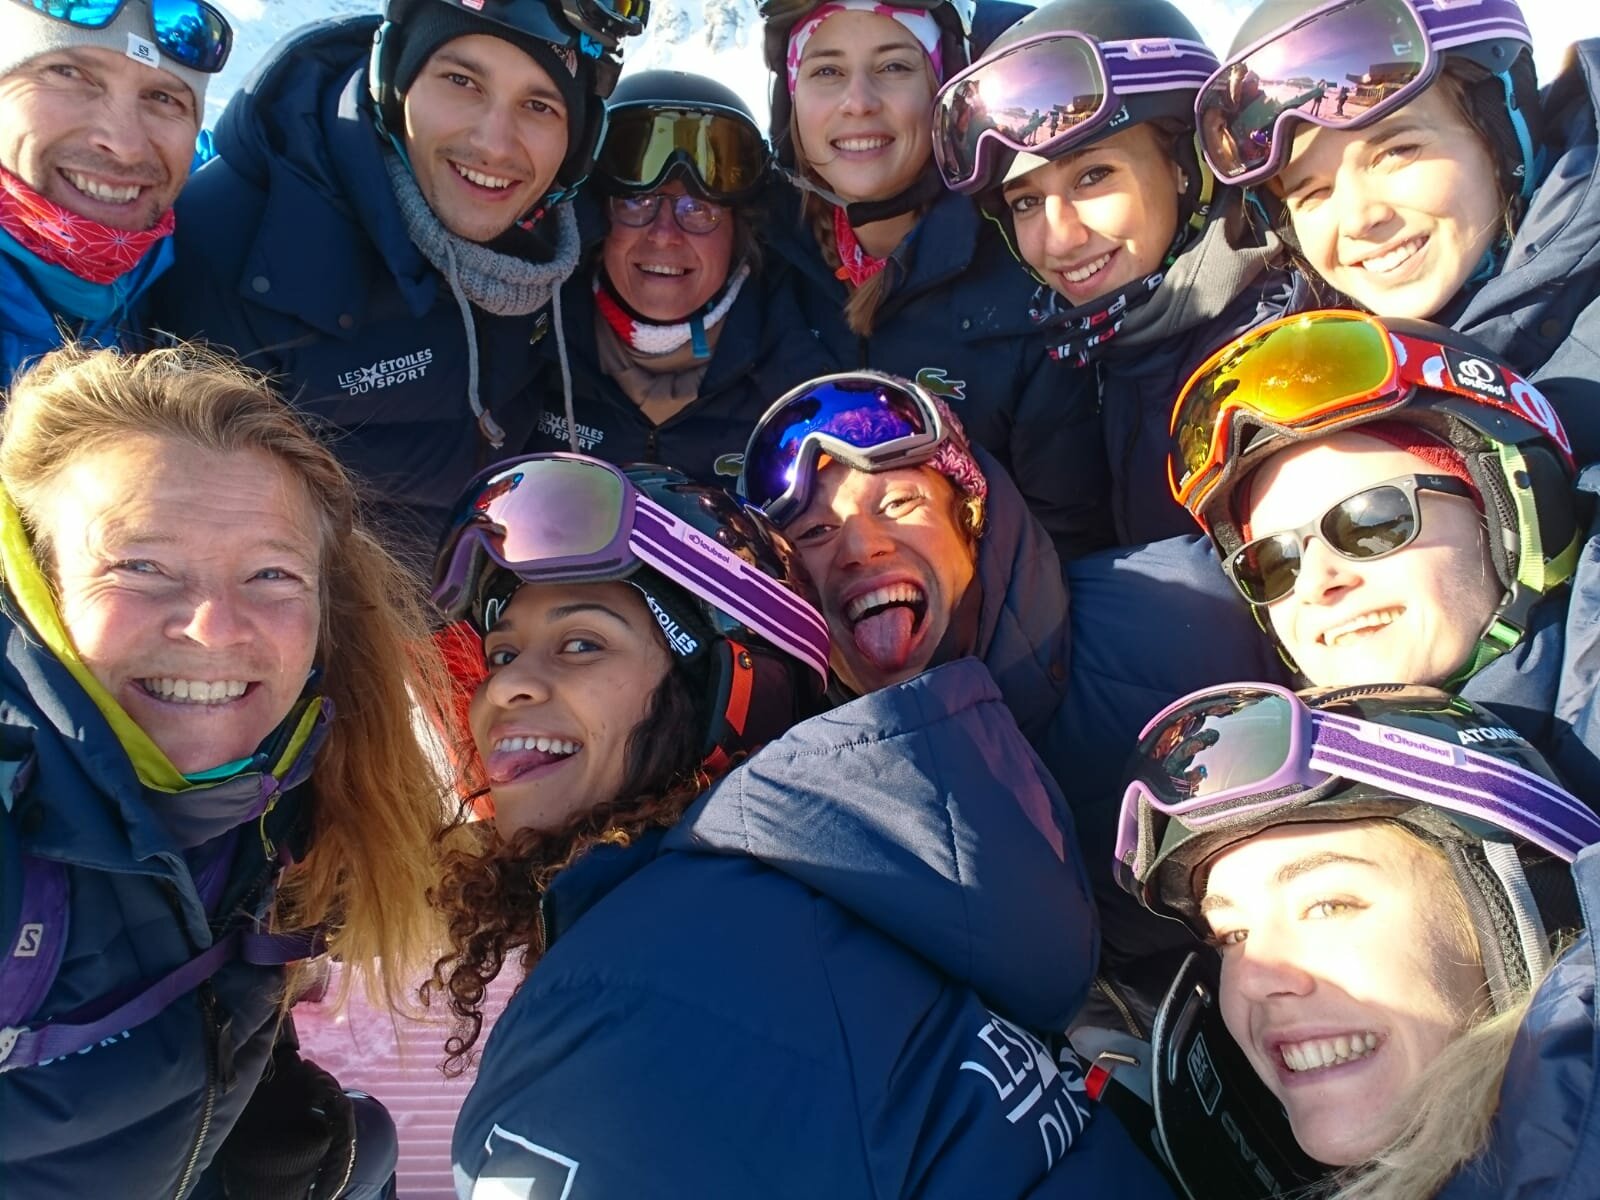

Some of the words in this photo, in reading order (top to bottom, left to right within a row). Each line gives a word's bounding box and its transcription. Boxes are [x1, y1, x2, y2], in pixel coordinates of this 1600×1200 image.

[337, 370, 362, 386] LES
[379, 348, 433, 374] ÉTOILES
[349, 382, 369, 396] DU
[377, 365, 427, 389] SPORT
[561, 416, 604, 441] ÉOILES
